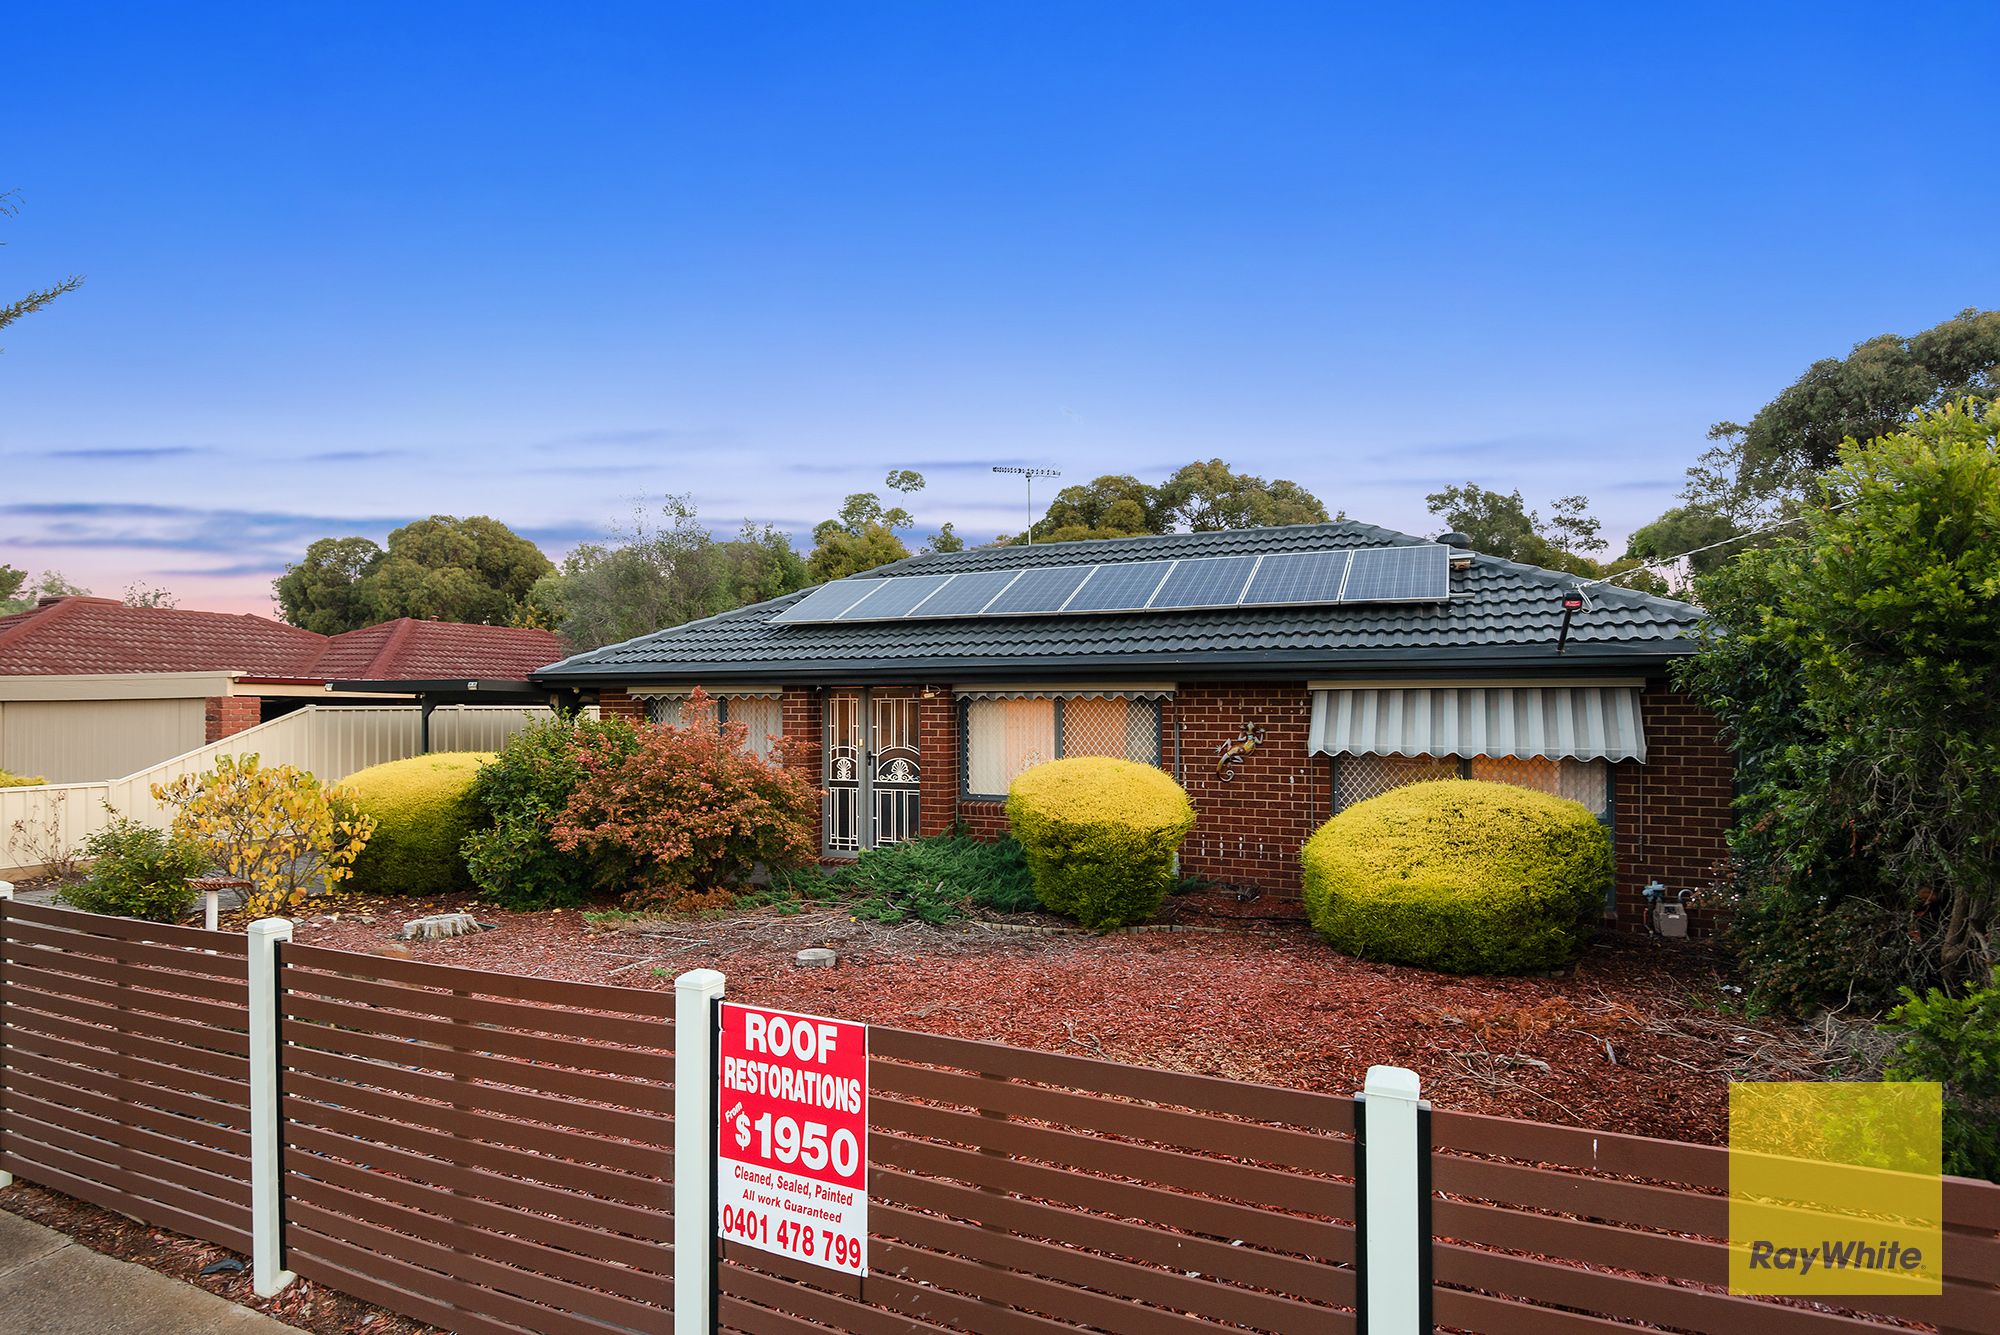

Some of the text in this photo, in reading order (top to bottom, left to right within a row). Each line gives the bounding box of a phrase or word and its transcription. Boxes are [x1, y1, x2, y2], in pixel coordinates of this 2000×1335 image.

[745, 1012, 838, 1064] ROOF
[724, 1056, 861, 1115] RESTORATIONS
[725, 1101, 743, 1123] From
[734, 1164, 853, 1207] Cleaned, Sealed, Painted
[742, 1188, 842, 1224] All work Guaranteed
[723, 1203, 861, 1269] 0401 478 799
